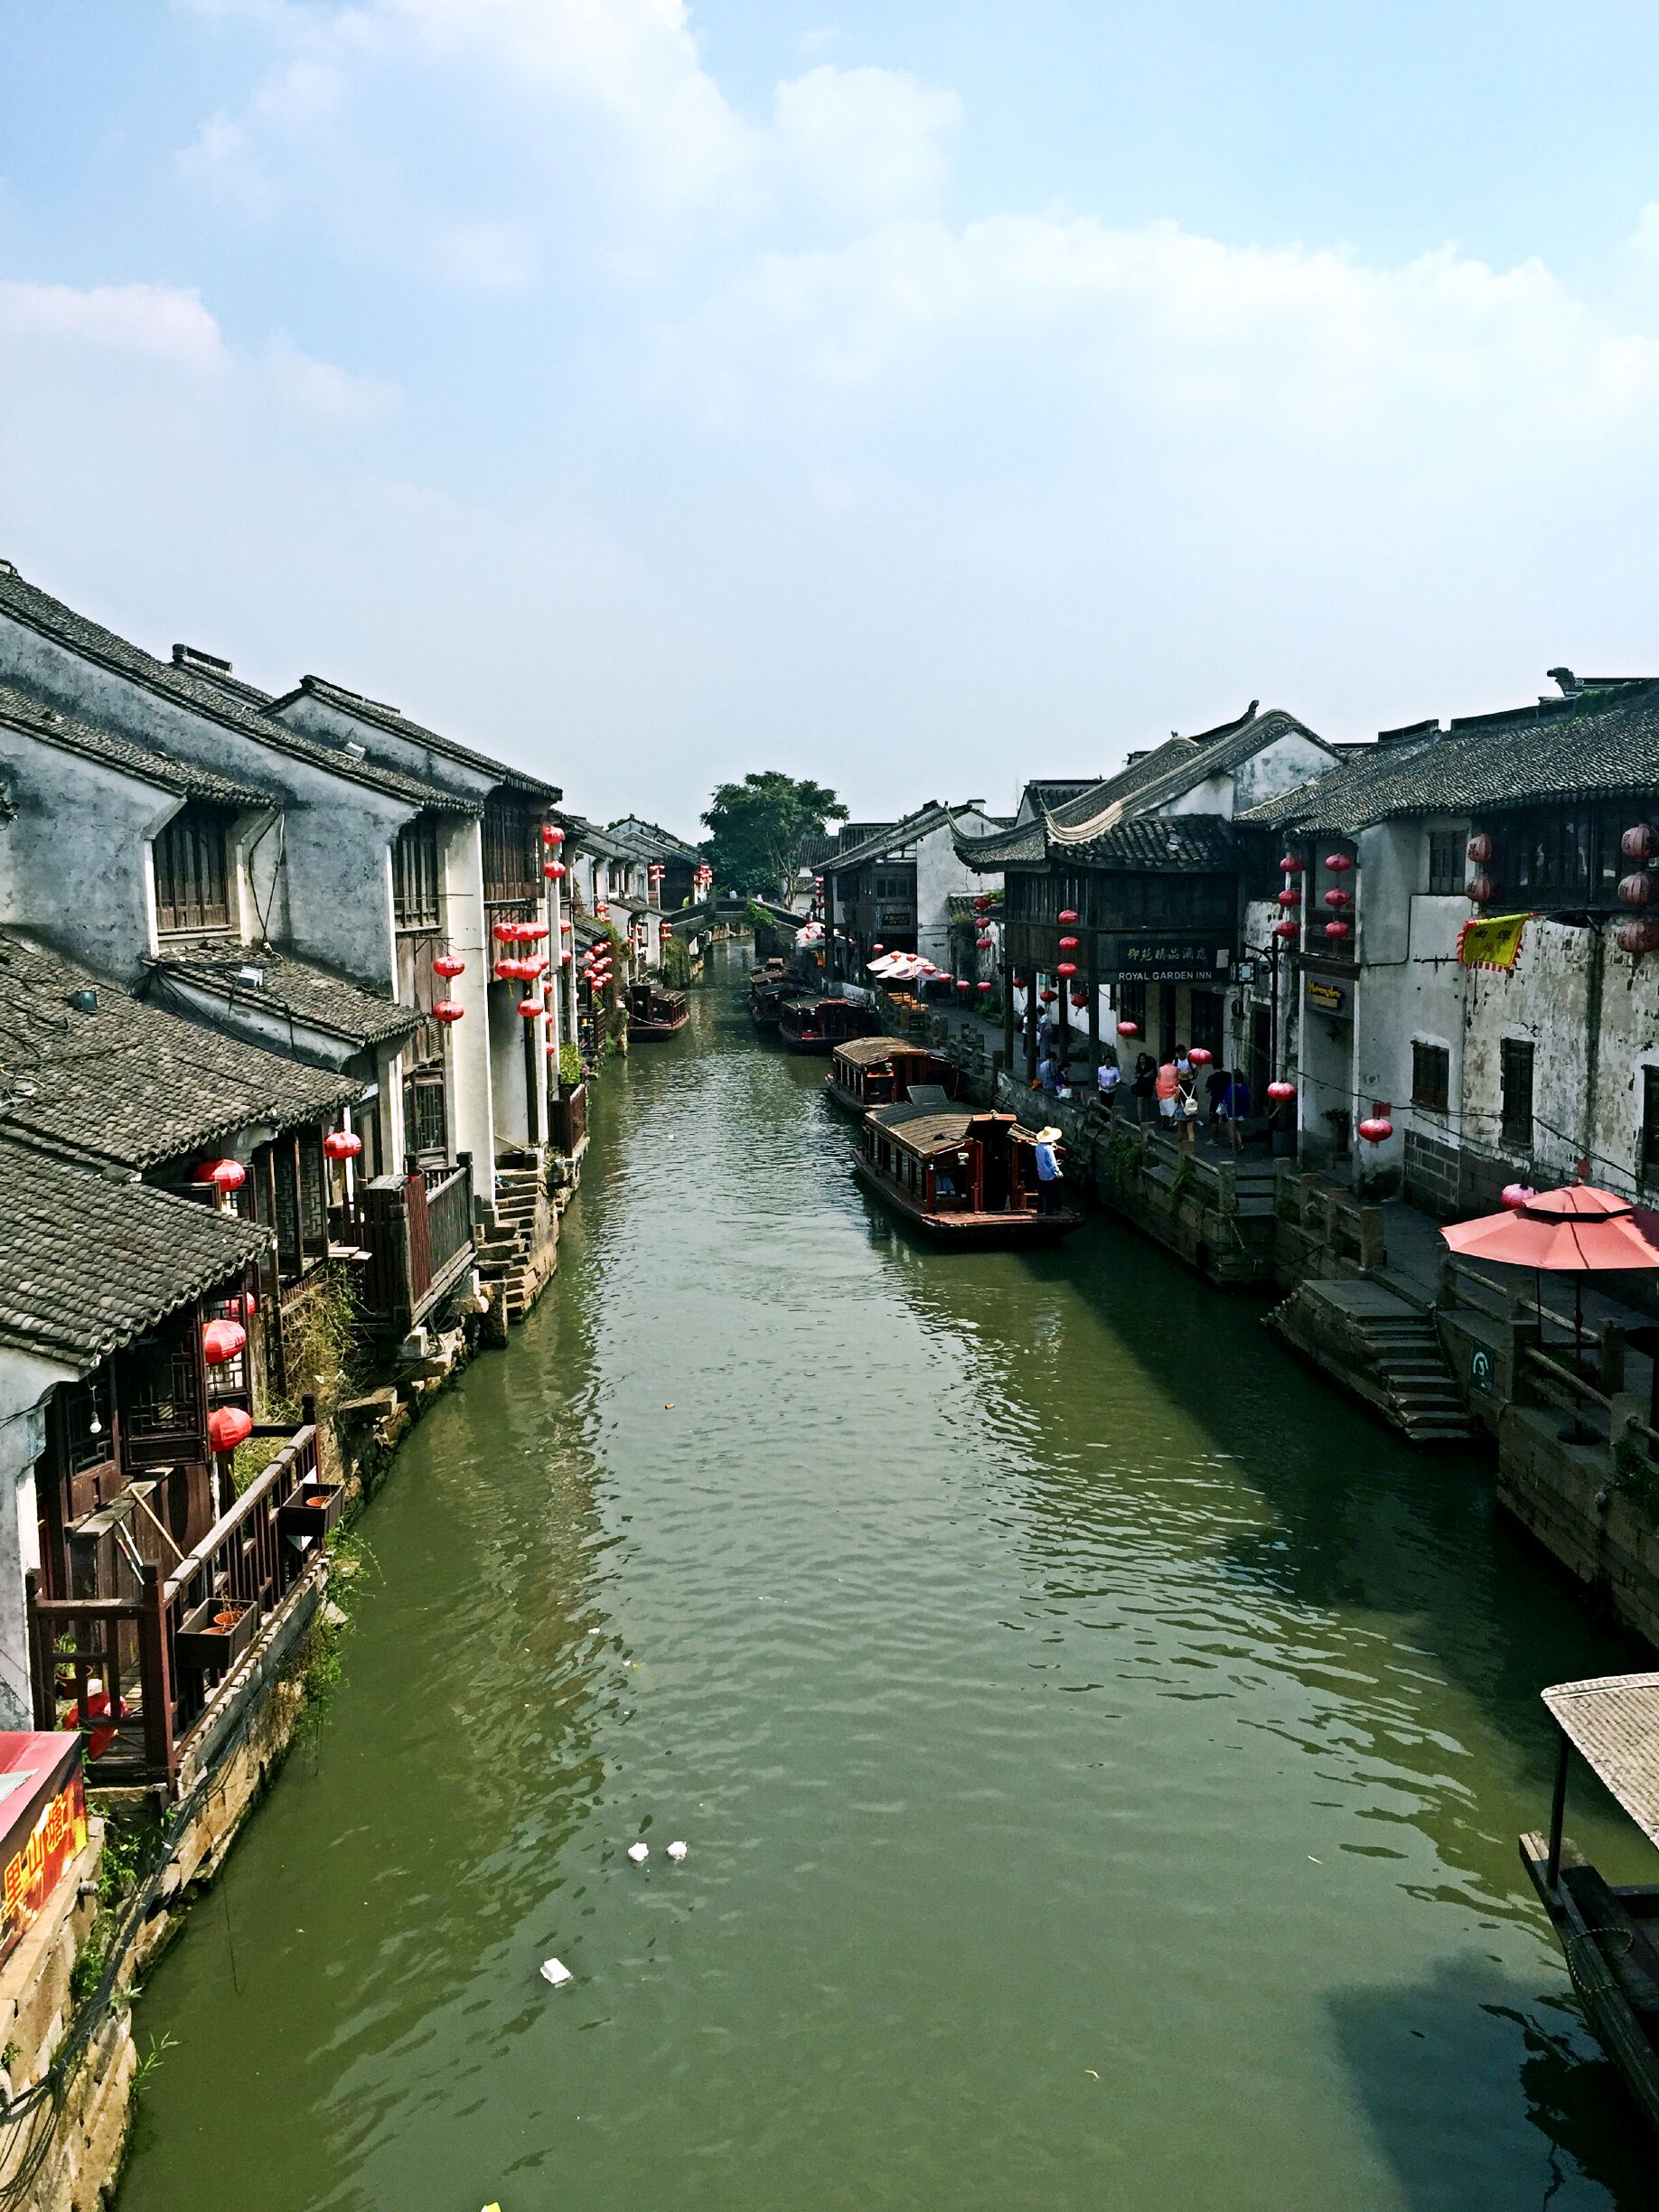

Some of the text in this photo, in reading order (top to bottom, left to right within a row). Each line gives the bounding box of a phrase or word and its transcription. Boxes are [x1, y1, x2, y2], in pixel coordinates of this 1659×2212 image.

[1119, 970, 1212, 980] ROYAL GARDEN INN
